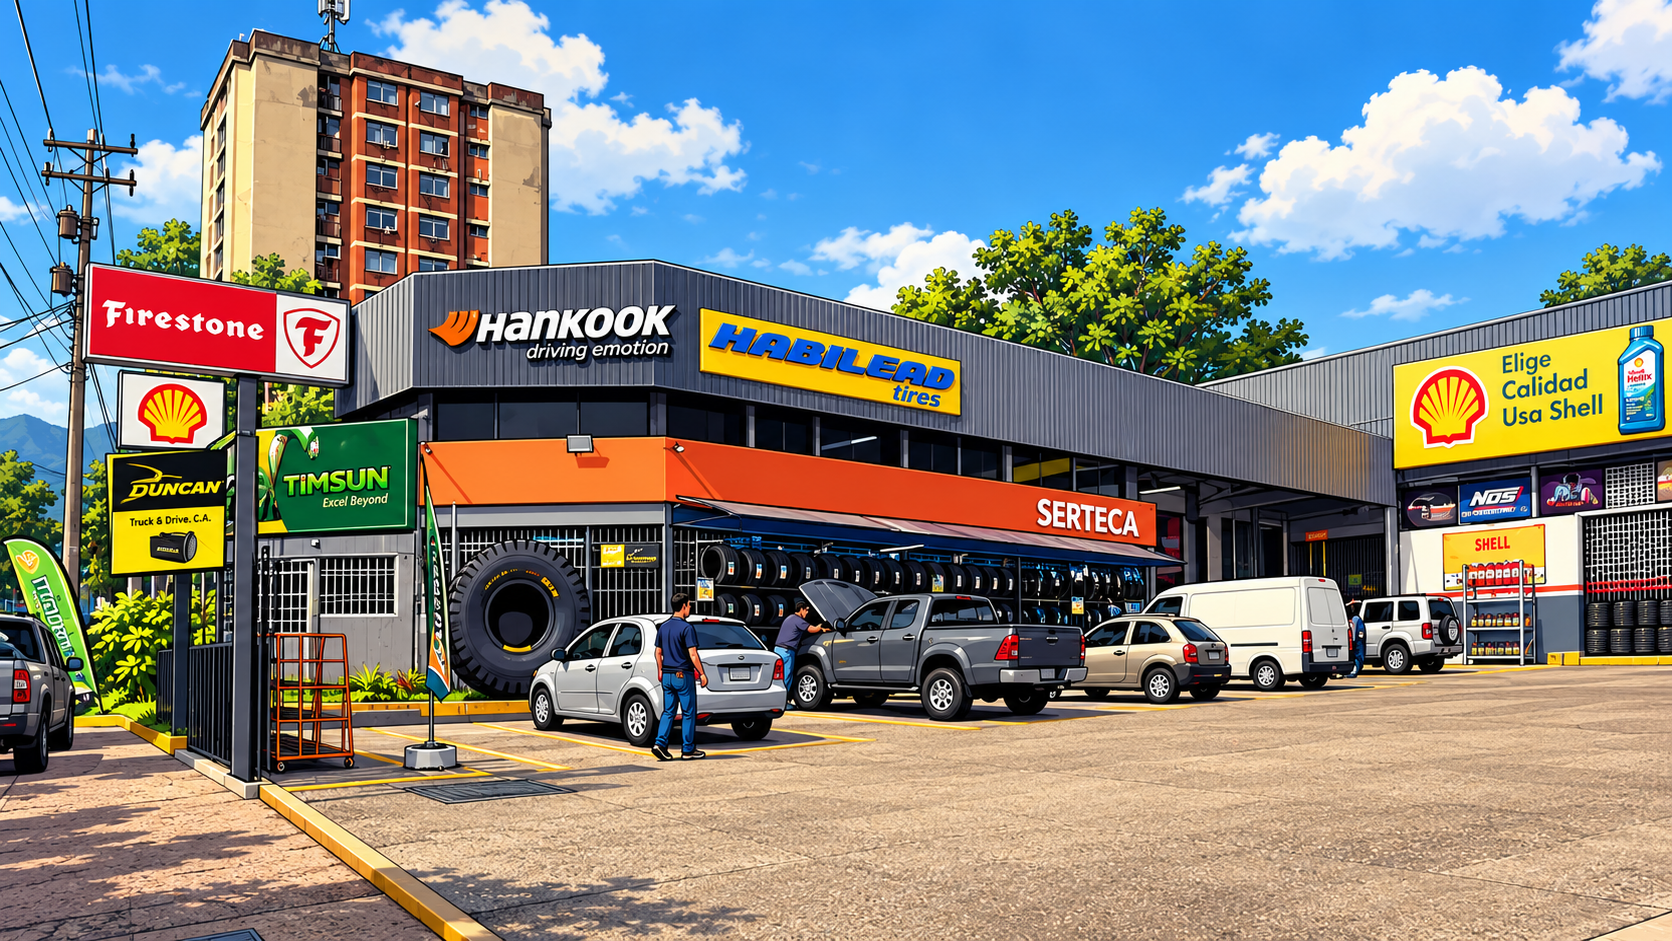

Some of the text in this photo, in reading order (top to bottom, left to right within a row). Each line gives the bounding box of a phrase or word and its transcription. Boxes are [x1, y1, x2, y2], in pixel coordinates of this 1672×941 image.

[102, 299, 264, 340] Firestone
[295, 316, 332, 357] F
[526, 339, 669, 361] driving emotion
[709, 322, 955, 390] HABILEAD
[1502, 351, 1551, 375] Elige
[893, 384, 941, 407] tires
[1502, 368, 1588, 400] Calidad
[1502, 407, 1542, 427] Usa
[1549, 394, 1603, 421] Shell
[122, 480, 222, 500] DUNCAN
[322, 493, 389, 508] Excel Beyond
[1469, 486, 1523, 507] NOS
[129, 517, 154, 527] Truck
[156, 516, 163, 525] &
[193, 513, 212, 524] C.A.
[1037, 498, 1140, 538] SERTECA
[1475, 536, 1511, 552] SHELL
